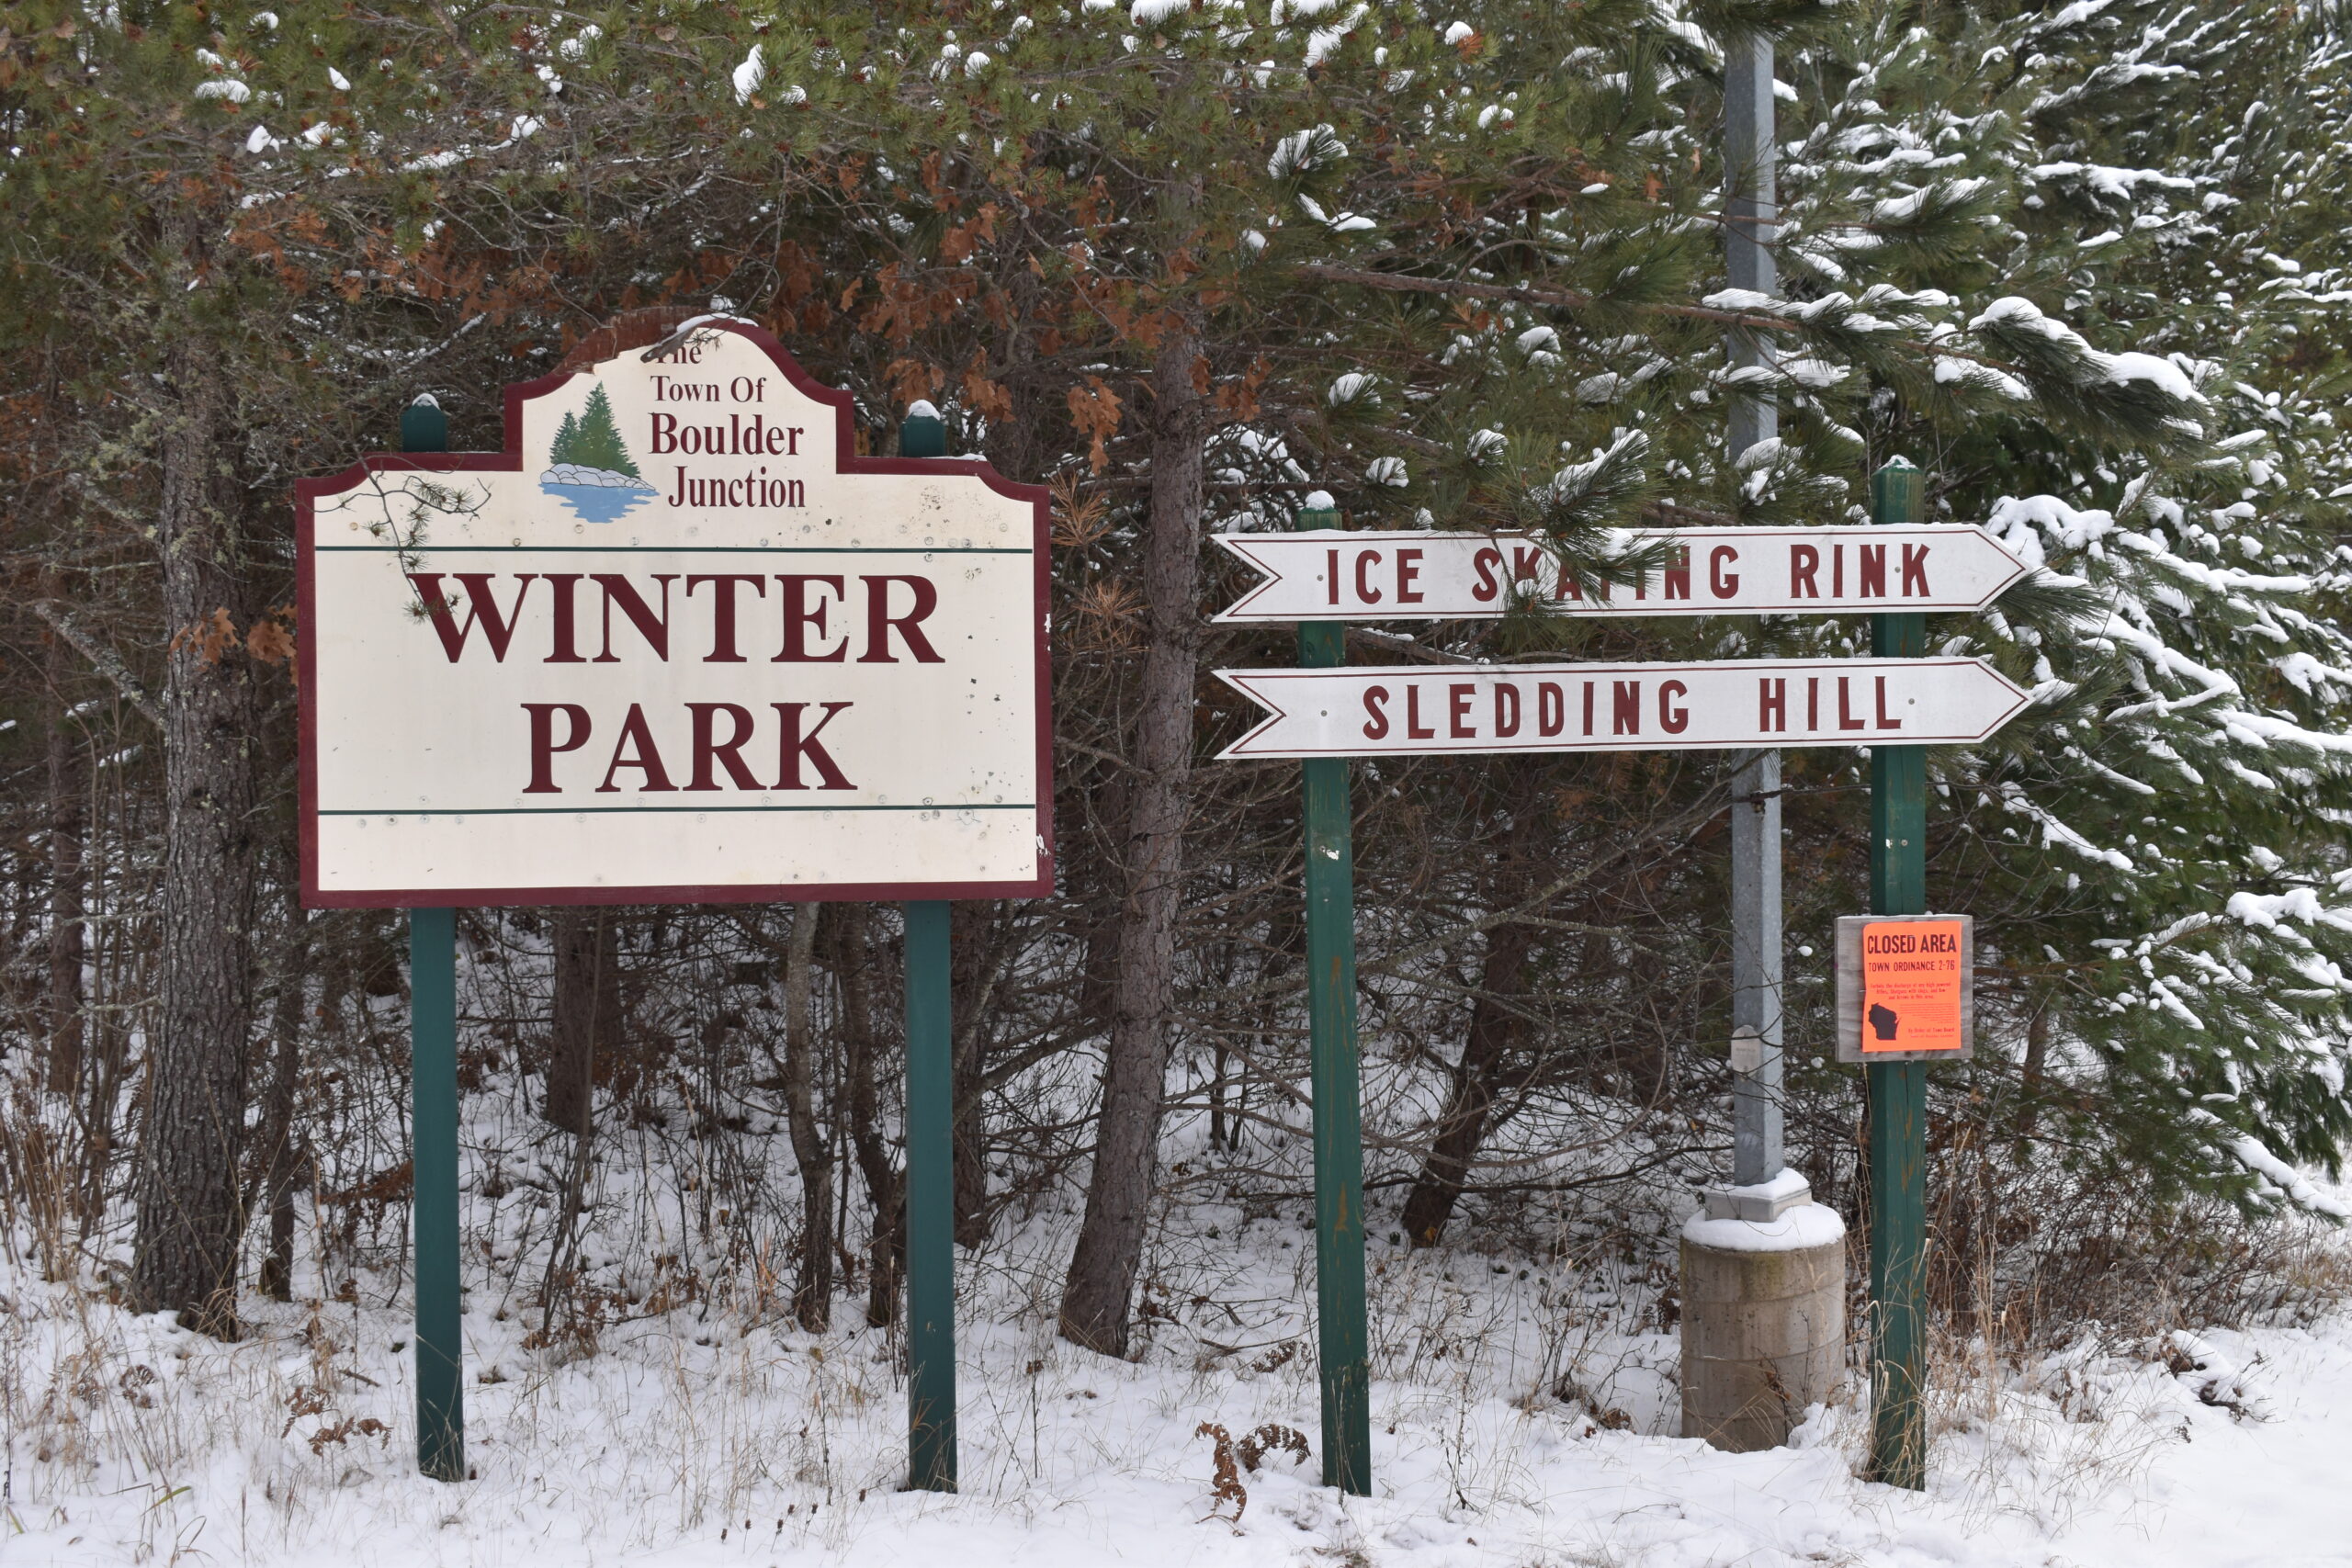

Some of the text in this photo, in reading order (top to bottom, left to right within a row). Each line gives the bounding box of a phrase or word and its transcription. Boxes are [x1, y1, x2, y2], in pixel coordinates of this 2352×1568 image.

[654, 343, 702, 365] he
[650, 375, 767, 403] Town Of
[648, 411, 804, 456] Boulder
[668, 465, 806, 508] Junction
[1327, 547, 1425, 605] ICE
[1790, 543, 1930, 599] RINK
[410, 572, 946, 663] WINTER
[1362, 675, 1902, 741] SLEDDING HILL
[520, 701, 858, 794] PARK
[1867, 933, 1957, 954] CLOSED AREA
[1868, 962, 1890, 973] TOWN
[1894, 960, 1936, 972] ORDINANCE
